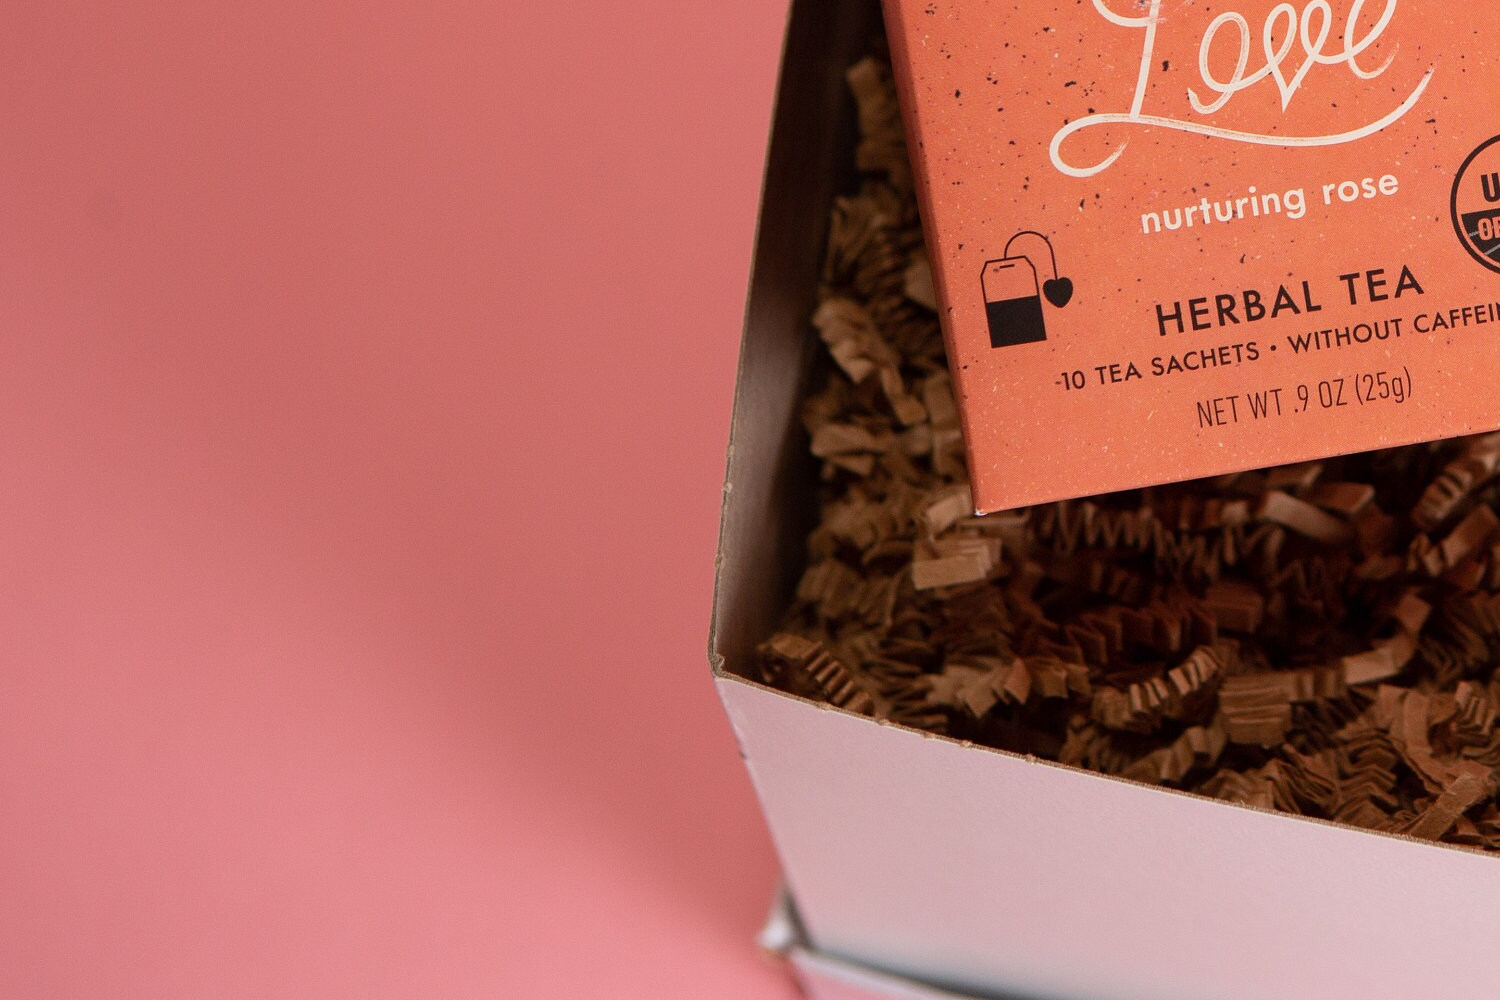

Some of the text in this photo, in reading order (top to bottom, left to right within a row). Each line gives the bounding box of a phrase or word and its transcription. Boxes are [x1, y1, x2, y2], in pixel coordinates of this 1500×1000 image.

[1141, 174, 1399, 234] nurturing rose
[1156, 265, 1425, 336] HERBAL TEA
[1095, 361, 1142, 385] TEA
[1151, 341, 1260, 376] SACHETS
[1287, 318, 1402, 354] WITHOUT
[1197, 366, 1411, 428] NET WT .9 OZ (25g)
